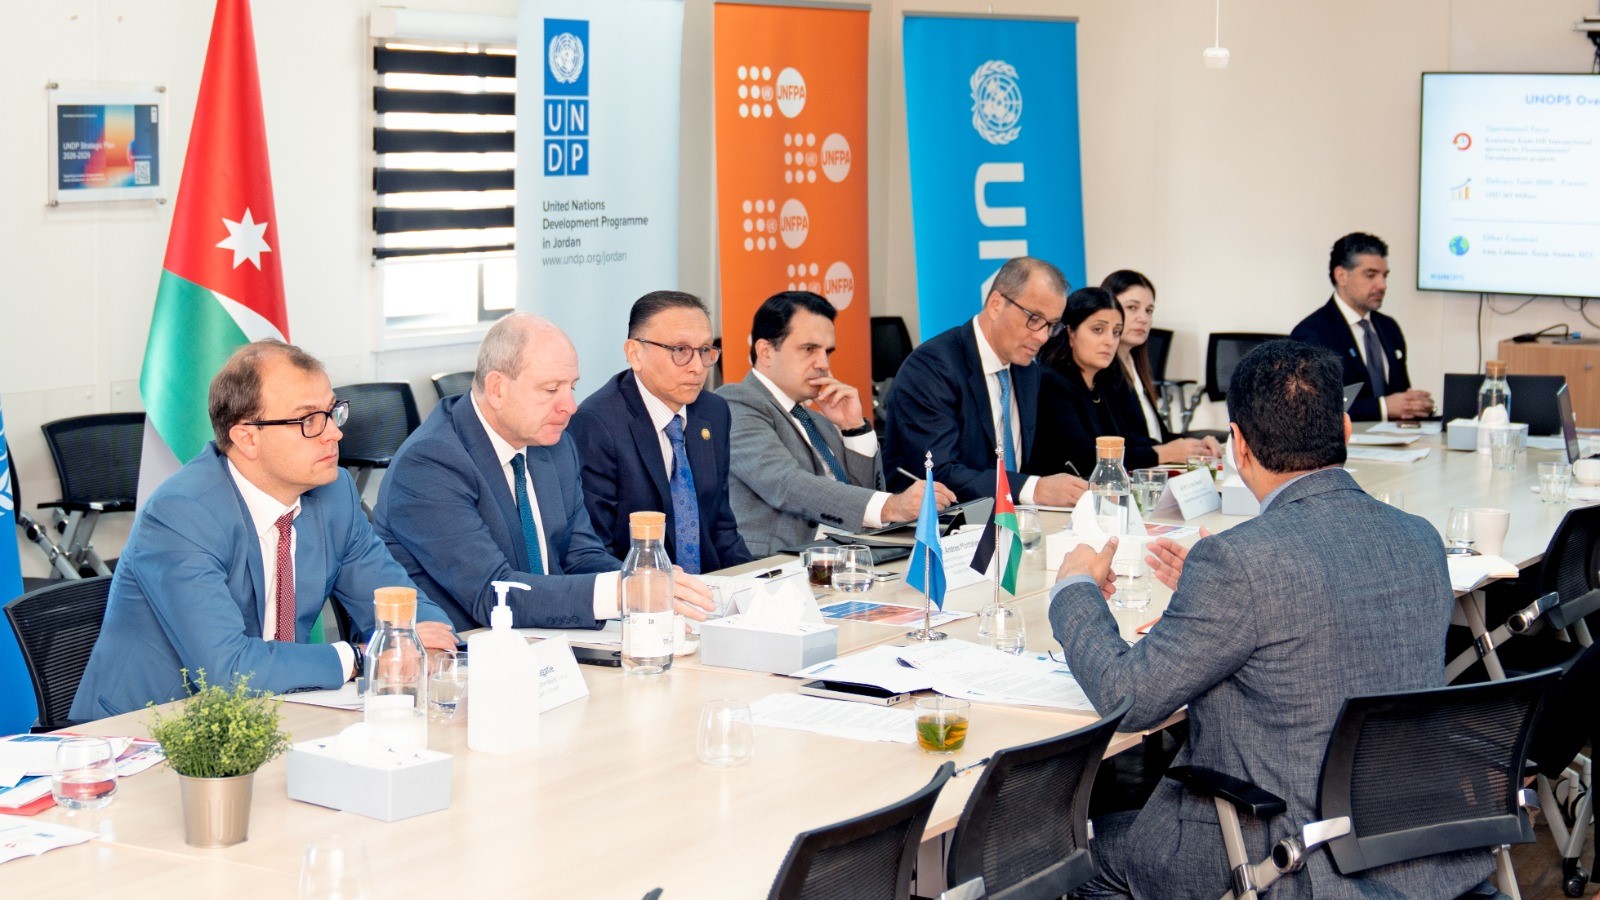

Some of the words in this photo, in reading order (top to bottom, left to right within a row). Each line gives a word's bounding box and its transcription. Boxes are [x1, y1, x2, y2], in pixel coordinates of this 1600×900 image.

[777, 85, 805, 101] UNFPA
[1525, 94, 1571, 105] UNOPS
[63, 142, 79, 150] UNDP
[822, 150, 851, 166] UNFPA
[543, 200, 569, 212] United
[572, 200, 606, 211] Nations
[543, 217, 599, 231] Development
[601, 216, 649, 229] Programme
[781, 216, 809, 232] UNFPA
[542, 237, 551, 249] in
[553, 236, 581, 249] Jordan
[542, 250, 627, 267] www.undp.org/jordan
[825, 278, 854, 294] UNFPA
